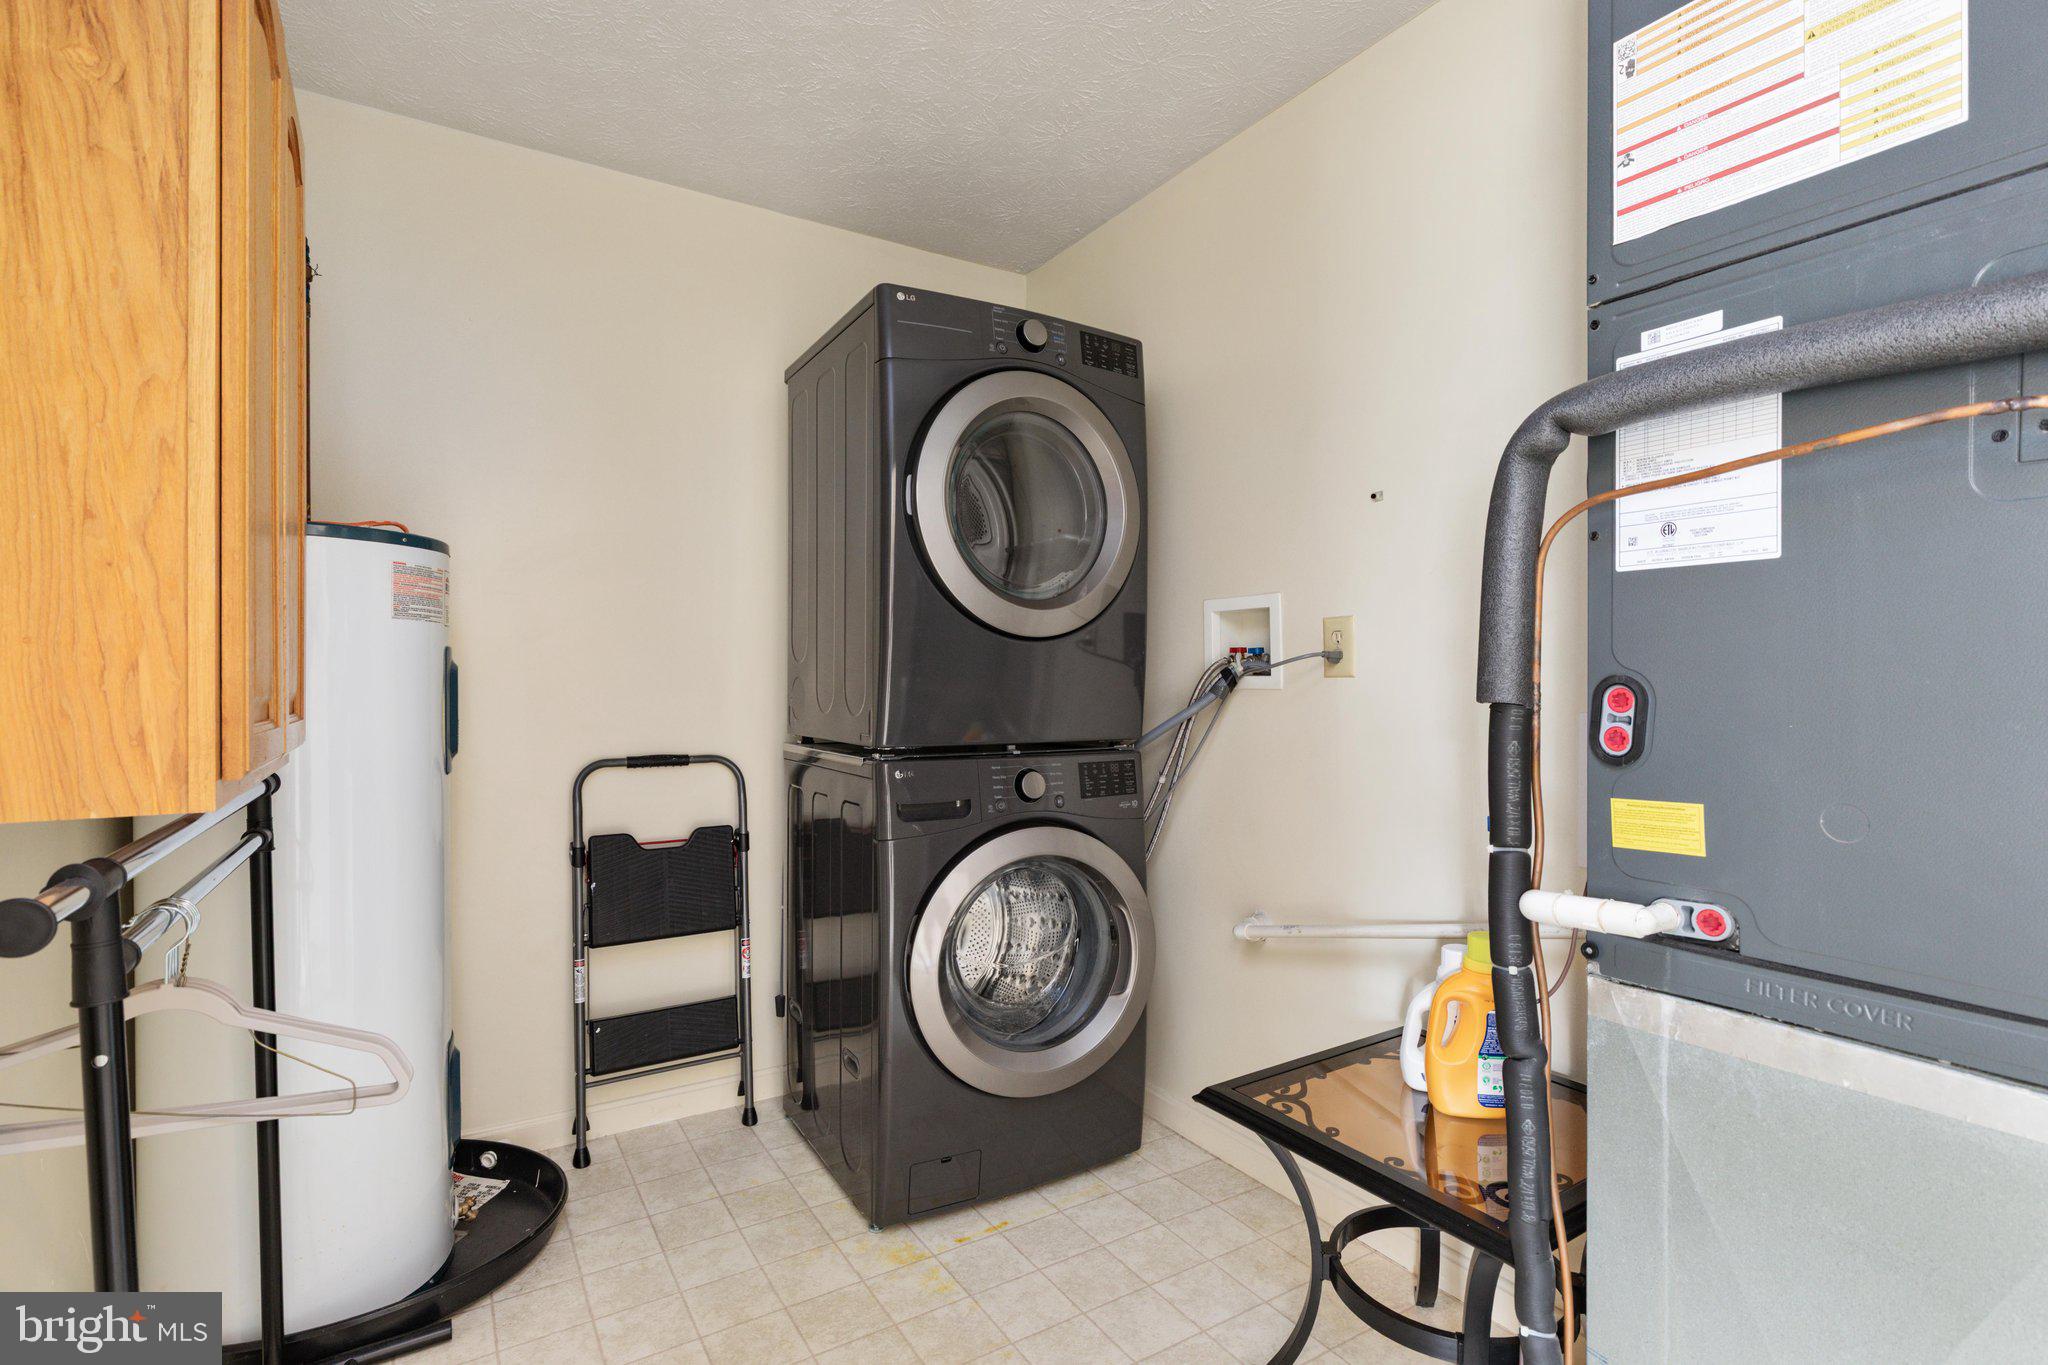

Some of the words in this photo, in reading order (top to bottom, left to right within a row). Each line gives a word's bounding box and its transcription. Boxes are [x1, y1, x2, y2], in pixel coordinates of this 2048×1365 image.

[1881, 34, 1916, 53] CAUTION
[1881, 69, 1925, 90] ATTENTION
[1683, 113, 1709, 127] DANGER
[1881, 115, 1925, 136] ATTENTION
[1683, 145, 1709, 159] DANGER
[1683, 177, 1711, 191] PELIGRO
[1746, 978, 1818, 1009] FILTER
[1827, 999, 1913, 1032] COVER
